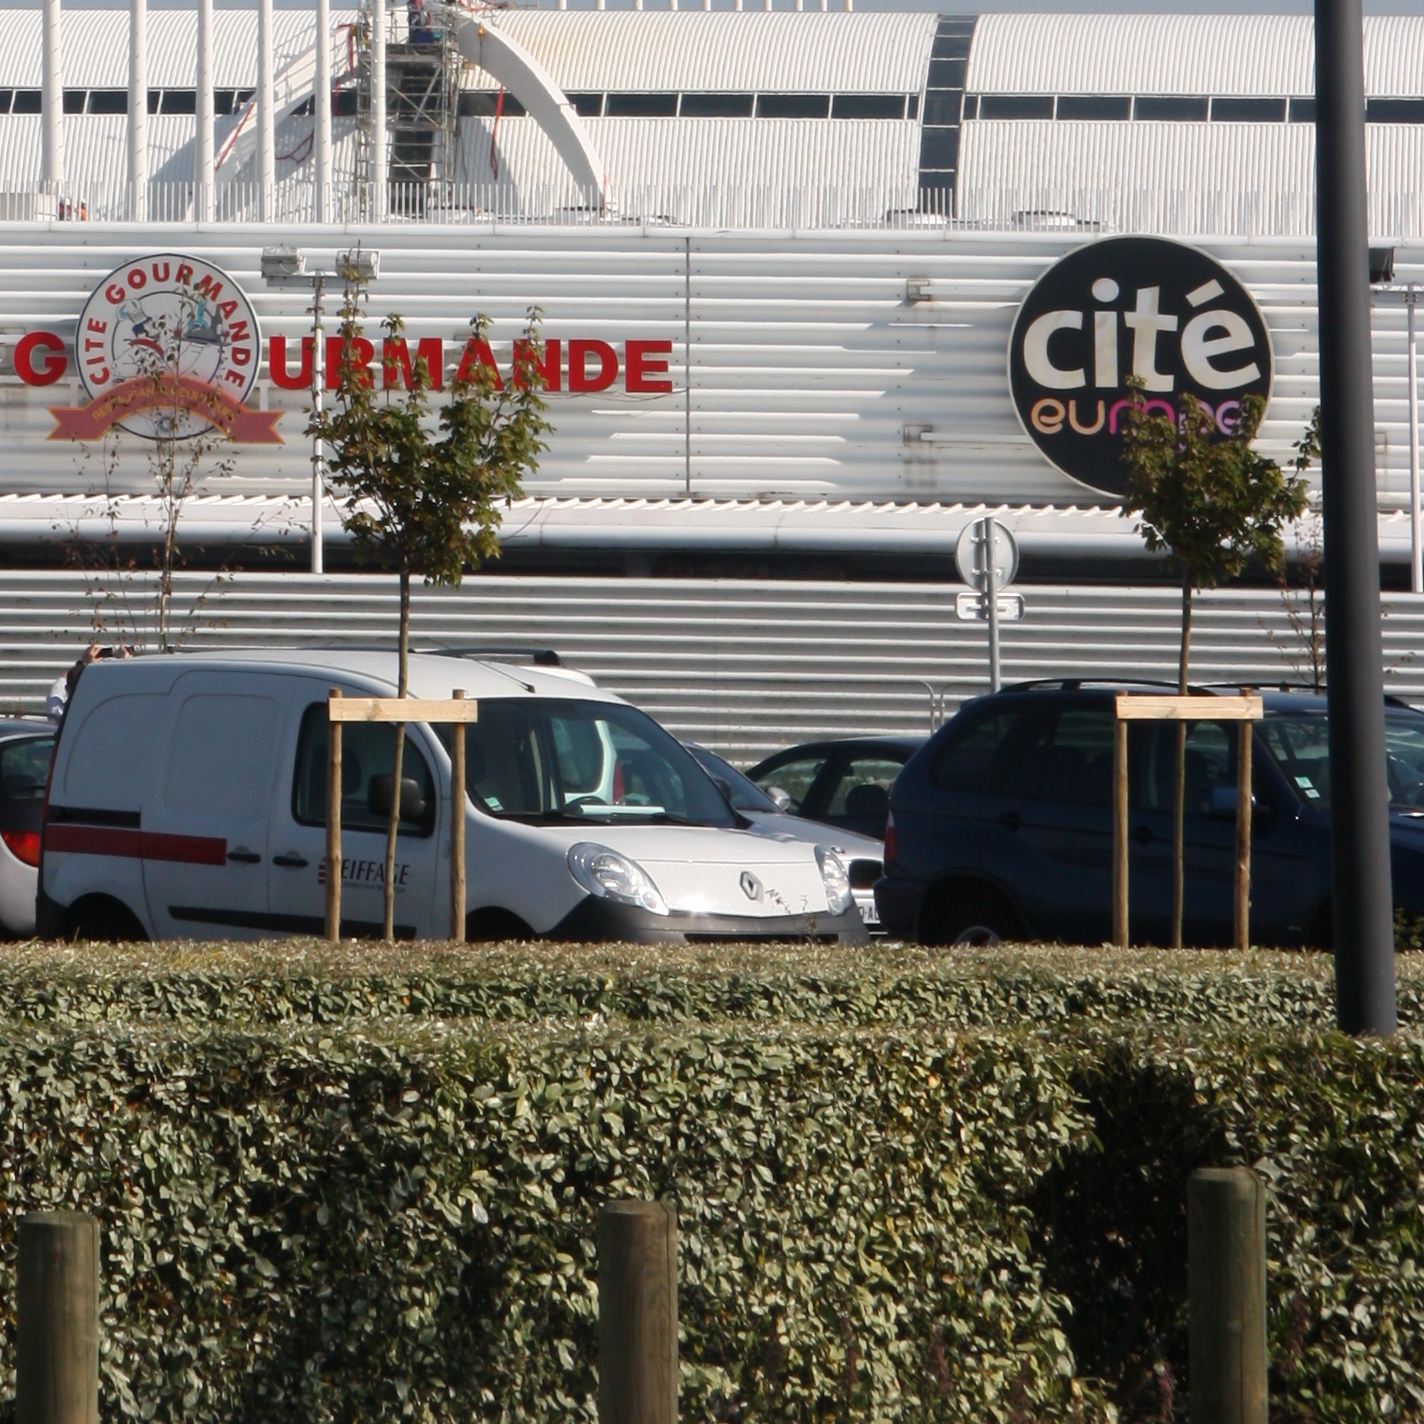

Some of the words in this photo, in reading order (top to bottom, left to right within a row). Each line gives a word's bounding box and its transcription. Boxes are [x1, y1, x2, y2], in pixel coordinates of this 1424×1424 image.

[85, 317, 110, 385] CITE
[105, 262, 251, 388] GOURMANDE
[1023, 277, 1261, 392] cité
[92, 386, 168, 422] RESAURAN
[179, 387, 236, 423] BOUTUES
